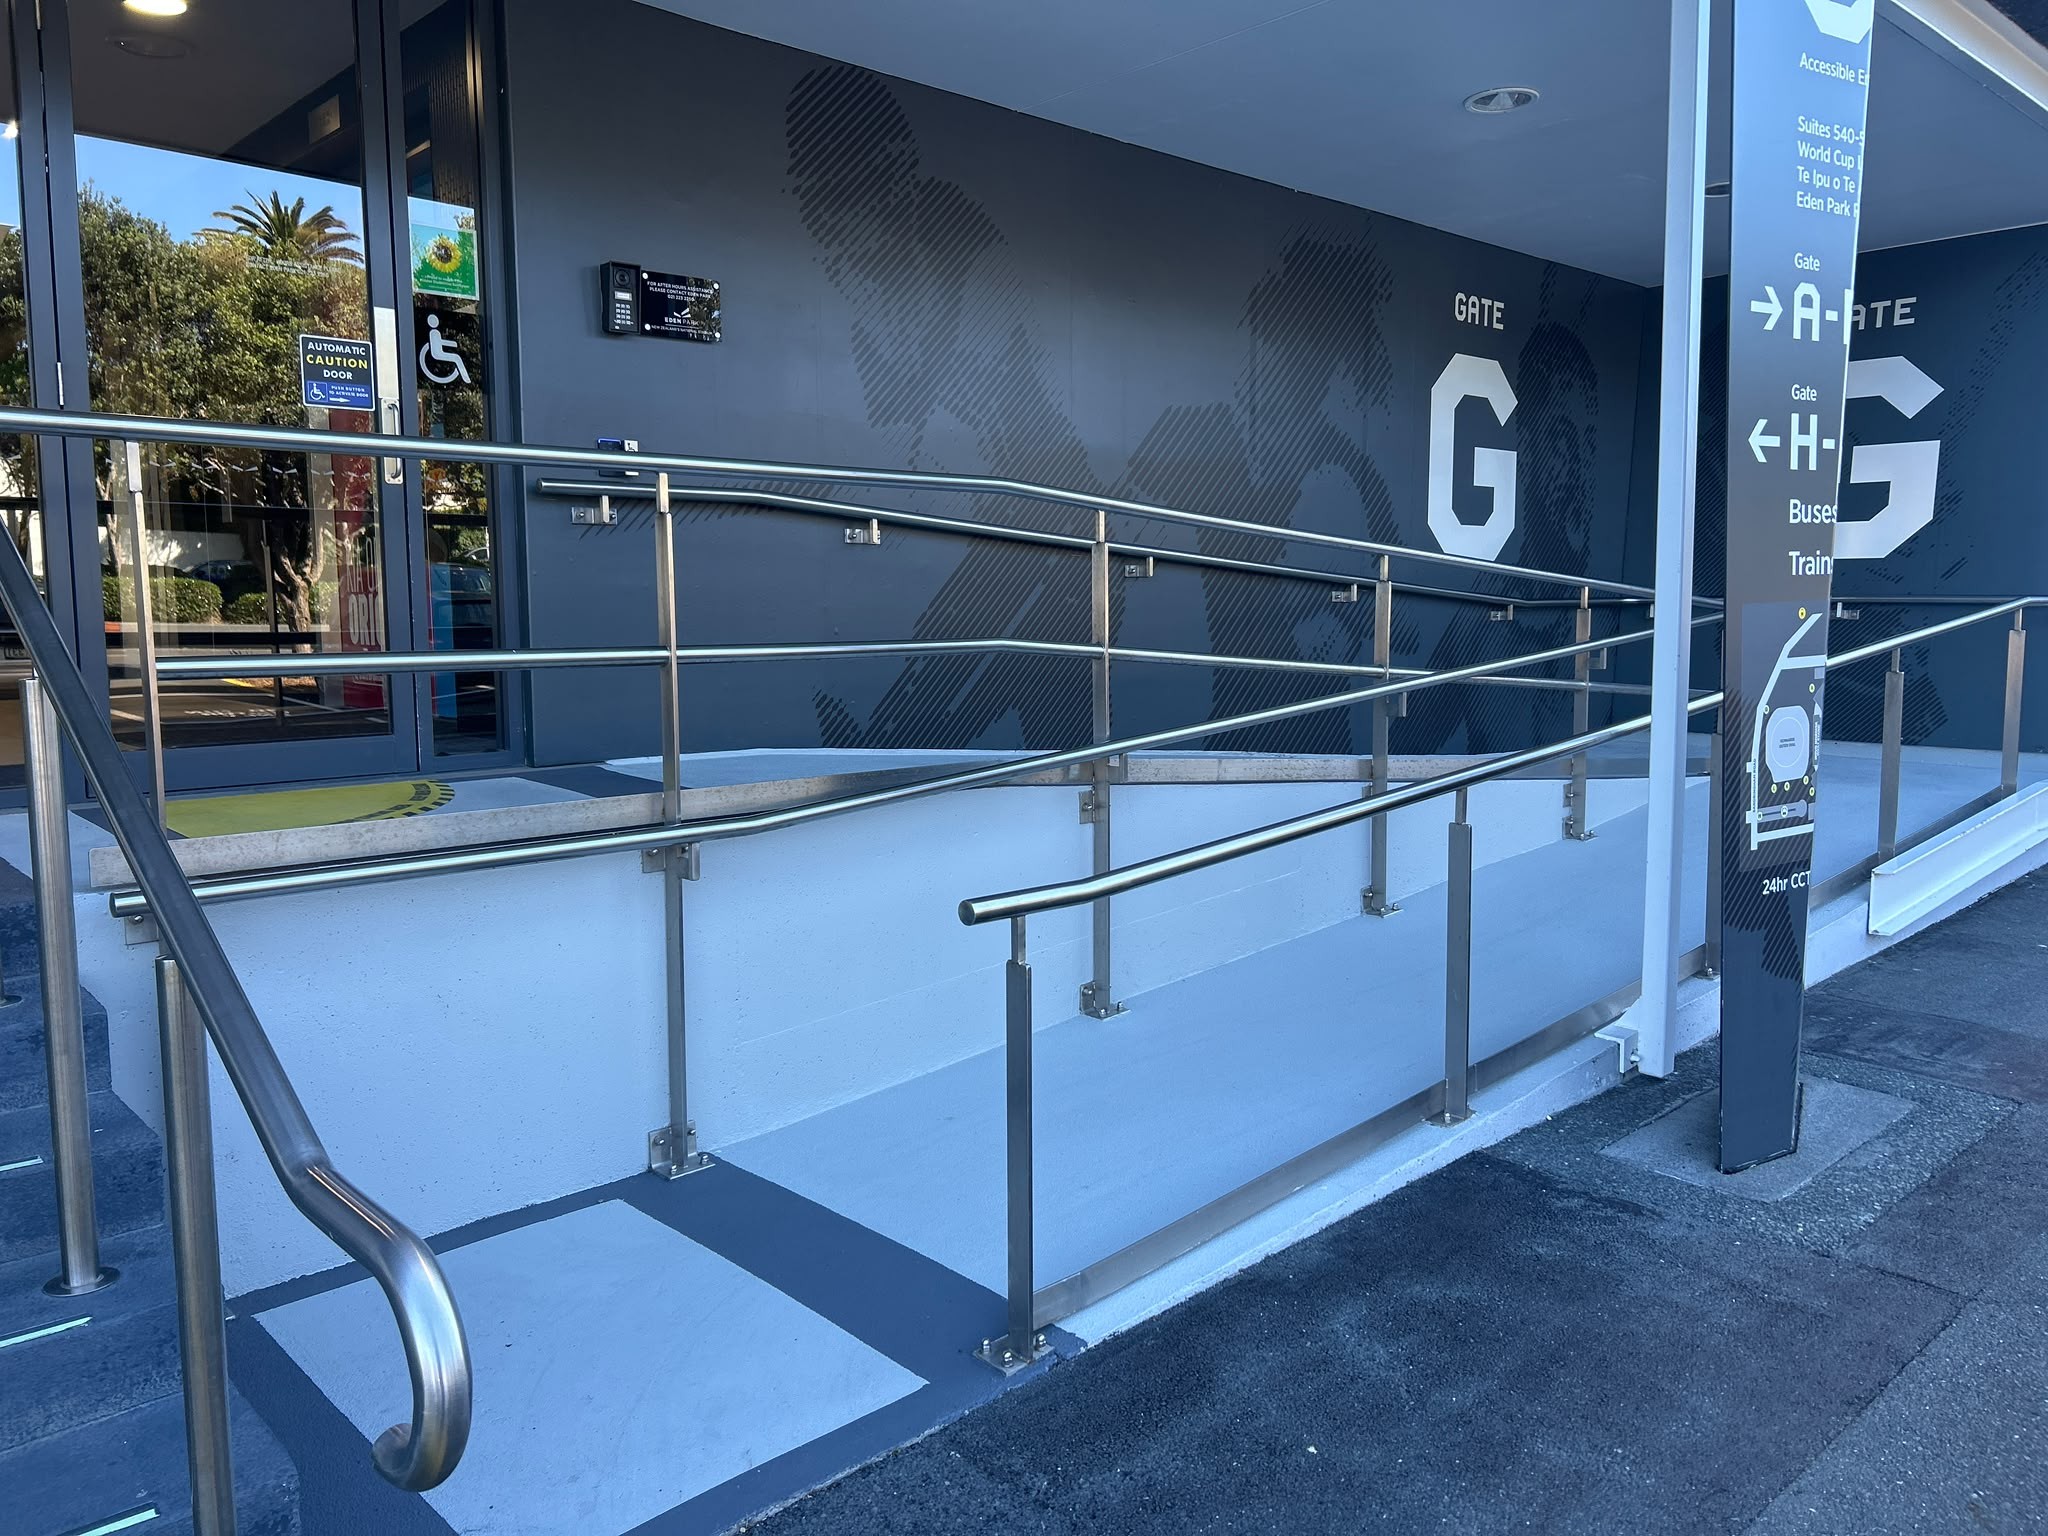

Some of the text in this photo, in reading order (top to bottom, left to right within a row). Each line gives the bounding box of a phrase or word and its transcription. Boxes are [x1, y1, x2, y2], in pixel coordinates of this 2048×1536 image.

[1800, 52, 1855, 82] Accessible
[1797, 115, 1831, 138] Suites
[1797, 140, 1831, 163] World
[1833, 149, 1855, 171] Cup
[1797, 165, 1855, 193] Te Ipu o Te
[1796, 190, 1824, 211] Eden
[1827, 196, 1850, 217] Park
[1794, 252, 1820, 271] Gate
[687, 286, 714, 294] ASSISTANCE
[1454, 292, 1505, 330] GATE
[1793, 282, 1853, 344] A-
[307, 342, 366, 356] AUTOMATIC
[306, 354, 368, 369] CAUTION
[323, 369, 353, 380] DOOR
[1791, 384, 1817, 401] Gate
[1427, 352, 1519, 562] G
[1789, 499, 1837, 524] Buses
[1762, 876, 1788, 895] 24hr
